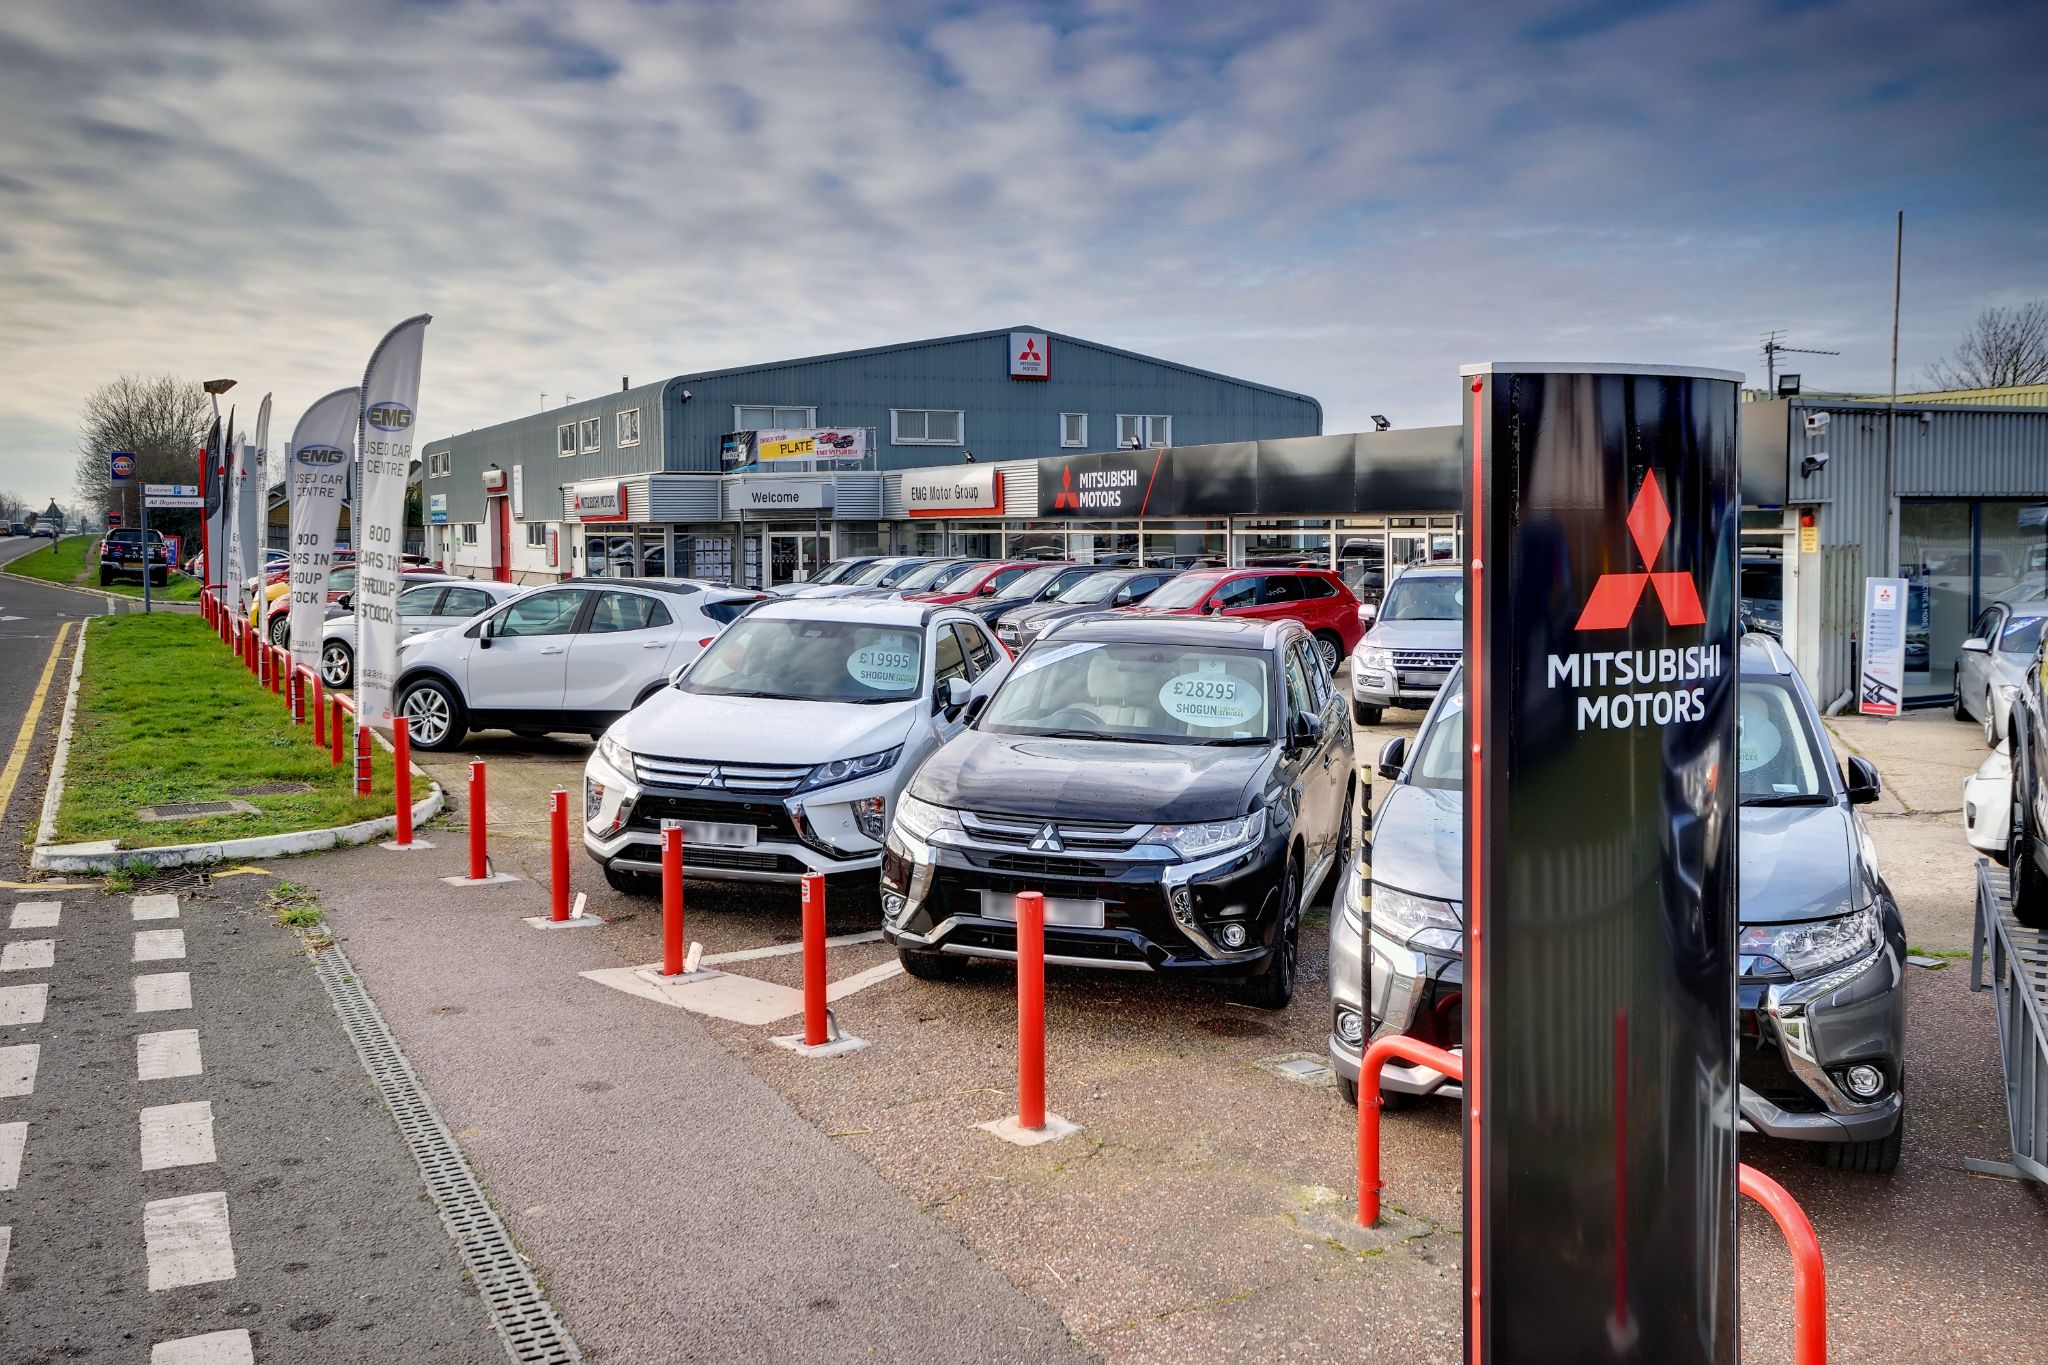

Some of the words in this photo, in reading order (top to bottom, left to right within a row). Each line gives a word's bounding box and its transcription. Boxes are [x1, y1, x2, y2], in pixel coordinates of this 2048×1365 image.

[370, 407, 410, 428] EMG
[392, 443, 410, 458] CAR
[780, 440, 812, 454] PLATE
[300, 450, 342, 464] EMG
[367, 460, 404, 476] CENTRE
[320, 474, 344, 484] CAR
[1080, 470, 1137, 488] MITSUBISHI
[751, 492, 800, 502] Welcome
[912, 486, 927, 500] EMG
[930, 486, 952, 500] Motor
[954, 484, 978, 502] Group
[1080, 490, 1122, 508] MOTORS
[369, 525, 390, 543] 800
[314, 554, 330, 566] IN
[360, 549, 384, 568] CARS
[388, 555, 400, 572] IN
[859, 652, 909, 668] £19995
[1548, 644, 1720, 688] MITSUBISHI
[860, 670, 894, 680] SHOGUN
[1174, 681, 1234, 700] £28295
[1176, 704, 1217, 716] SHOGUN
[1577, 688, 1705, 730] MOTORS
